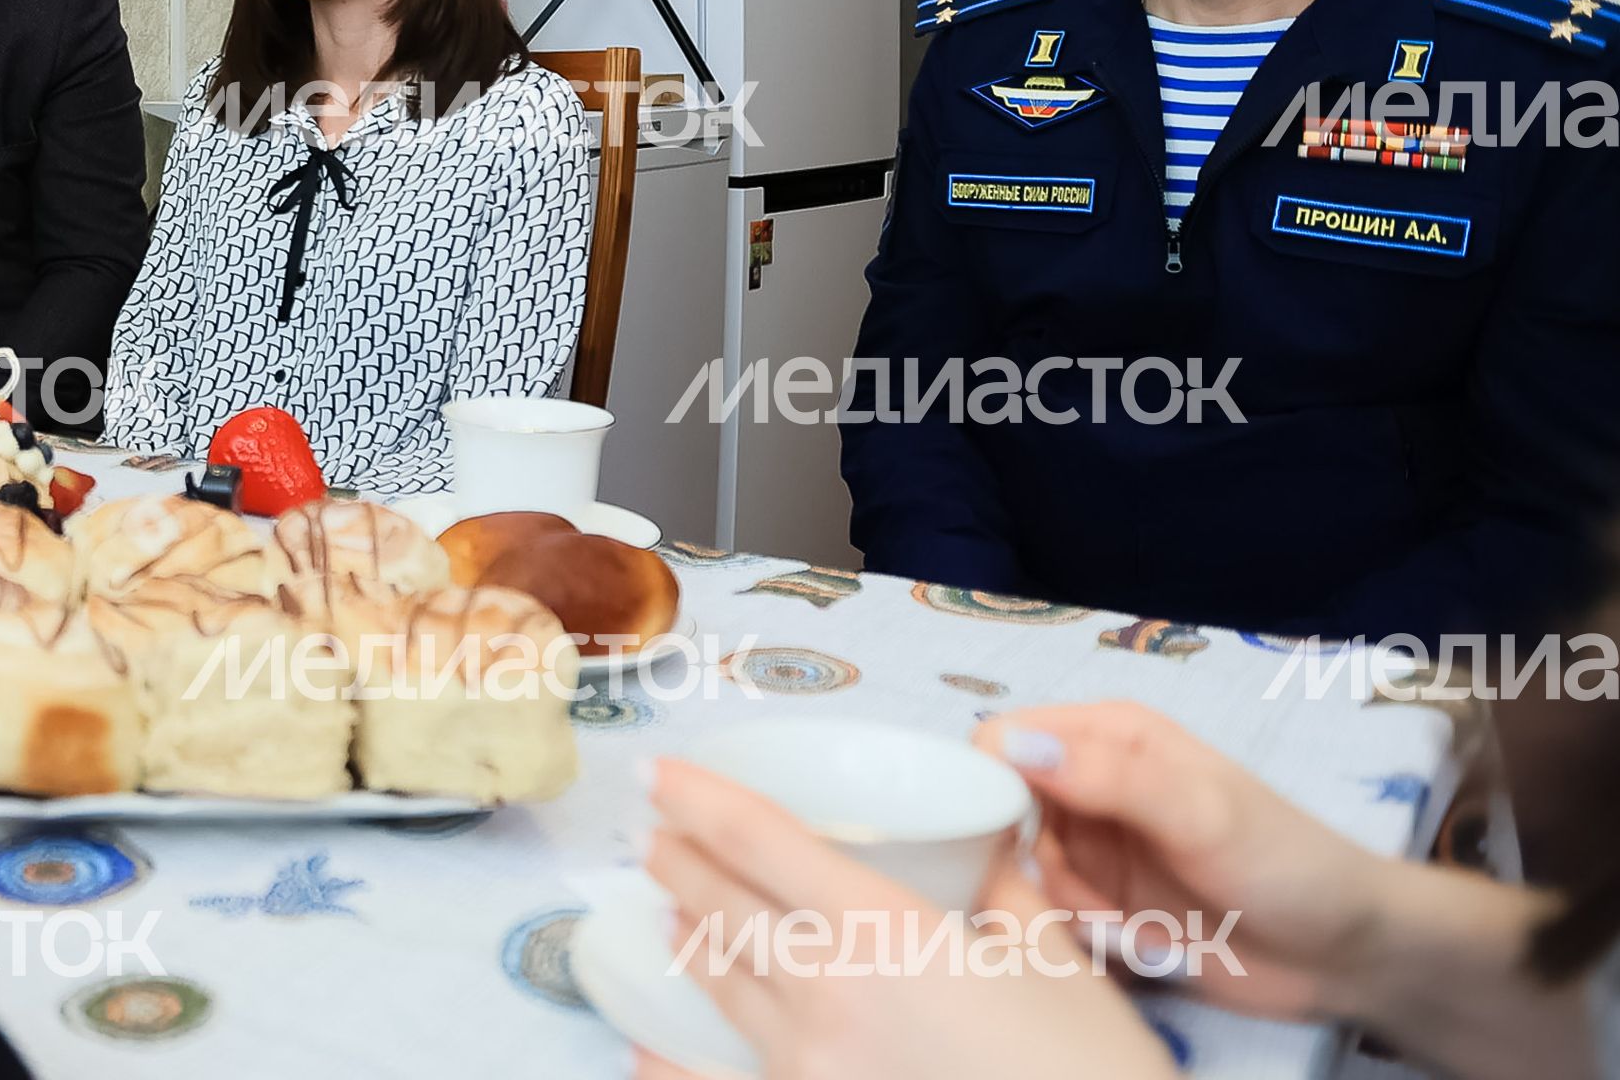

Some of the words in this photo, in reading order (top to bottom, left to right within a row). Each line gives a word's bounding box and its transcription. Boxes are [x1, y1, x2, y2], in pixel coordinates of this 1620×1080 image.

[952, 183, 1021, 201] ВООРУЖЕННЫЕ
[1023, 186, 1049, 203] СИЛЫ
[1051, 186, 1090, 205] РОССИИ
[1295, 206, 1395, 238] ПРОШИН
[1404, 220, 1448, 245] А.А.
